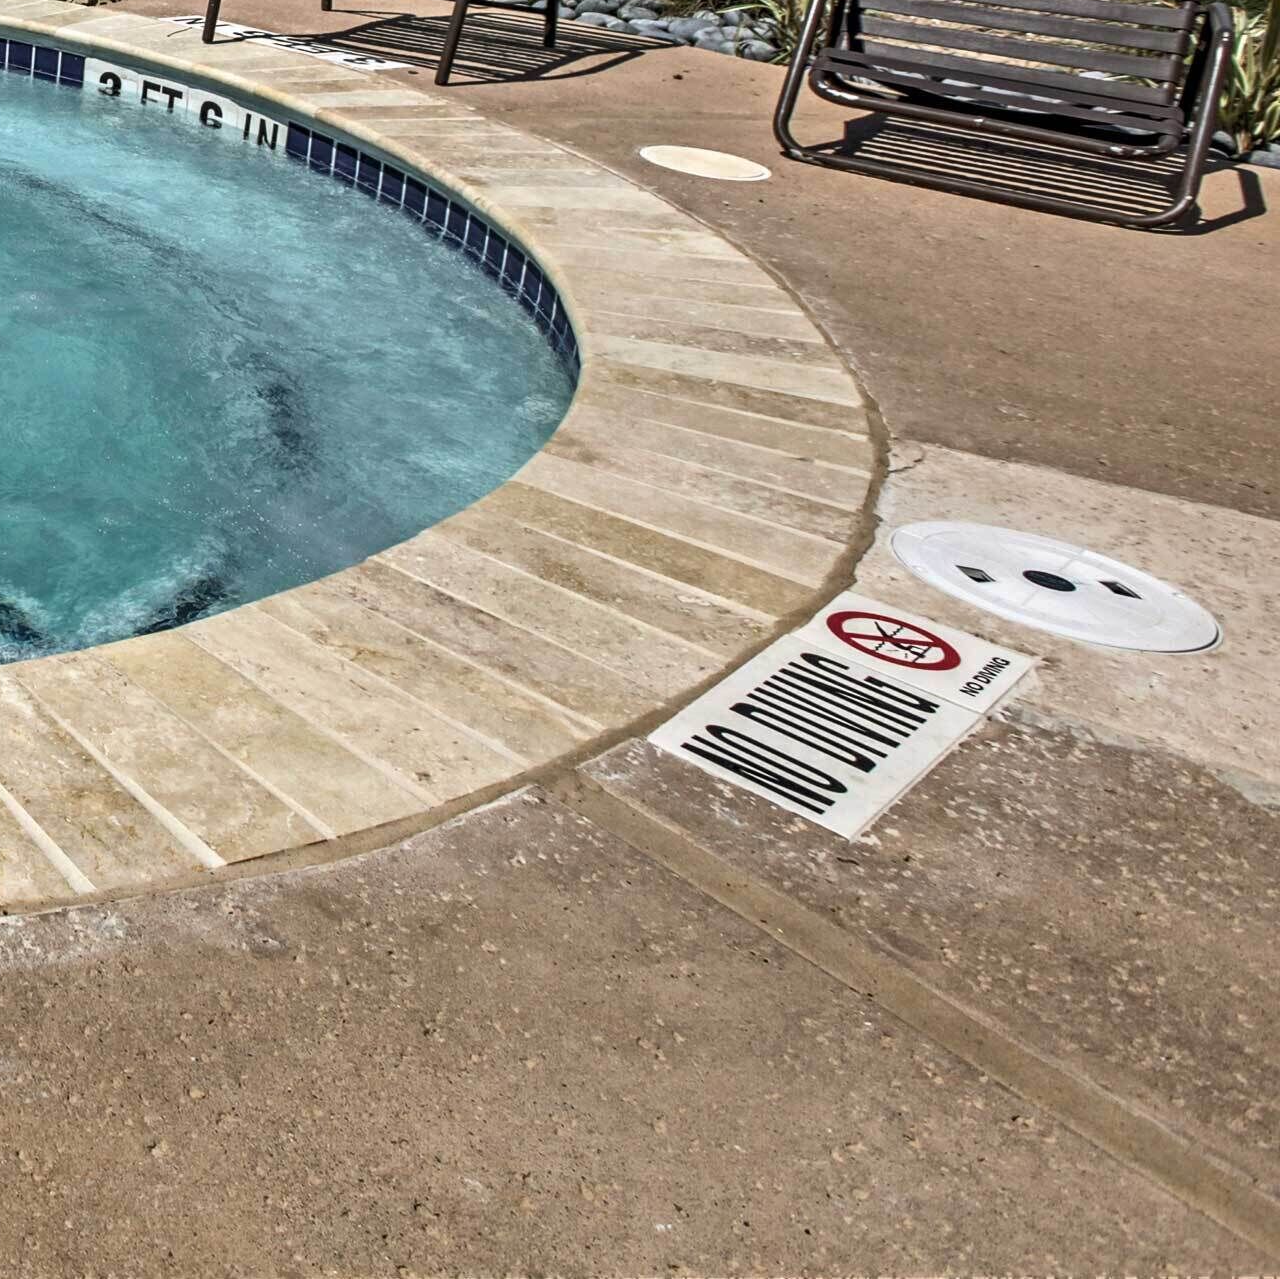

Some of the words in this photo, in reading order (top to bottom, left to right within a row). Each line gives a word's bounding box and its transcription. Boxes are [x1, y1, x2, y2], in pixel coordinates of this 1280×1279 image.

[141, 80, 183, 112] FT
[243, 113, 279, 150] IN
[729, 652, 941, 773] DIVING
[959, 681, 984, 698] NO
[973, 656, 1010, 685] DIVING
[681, 724, 848, 815] NO
